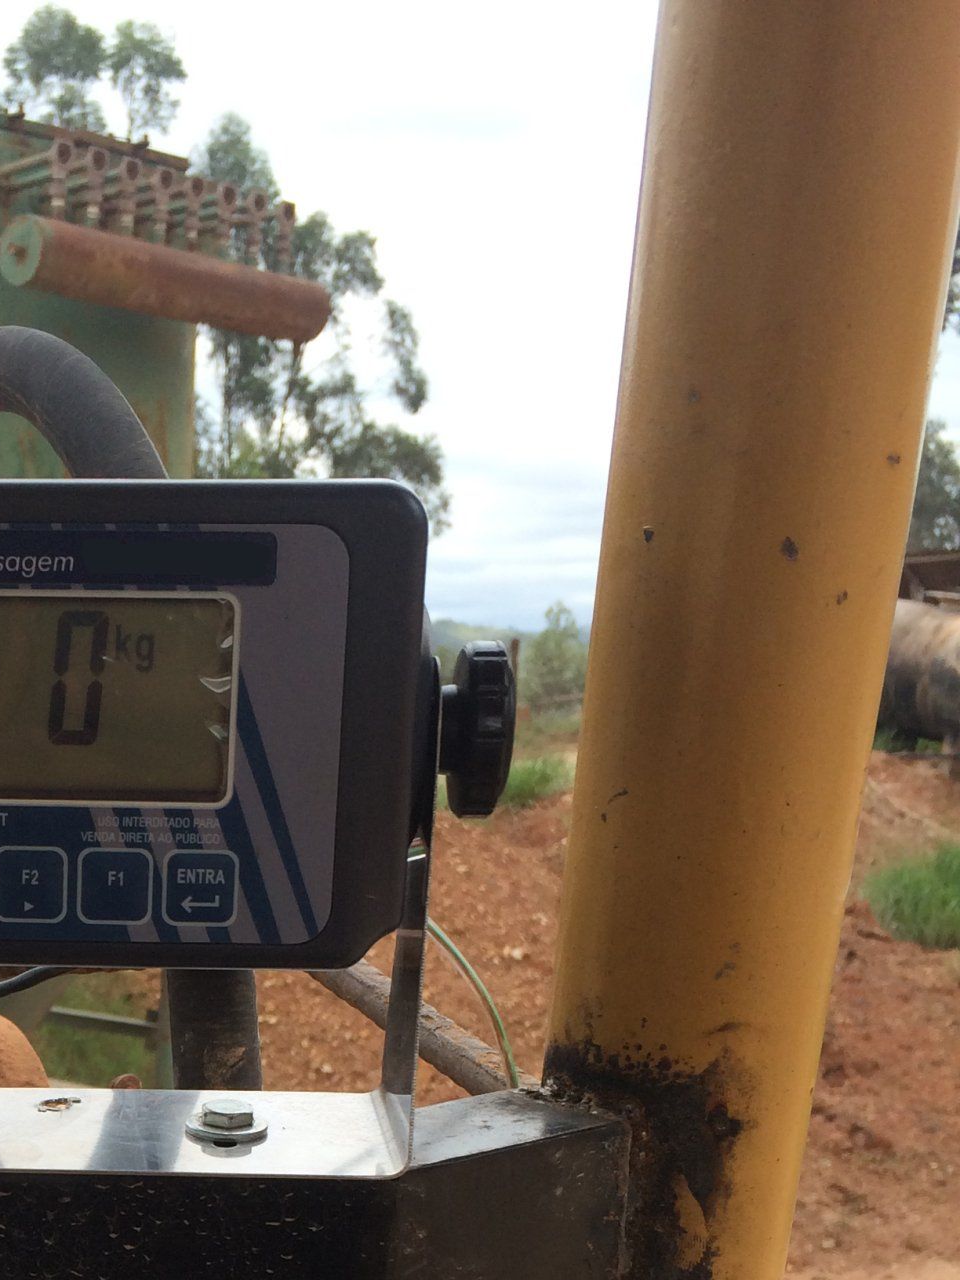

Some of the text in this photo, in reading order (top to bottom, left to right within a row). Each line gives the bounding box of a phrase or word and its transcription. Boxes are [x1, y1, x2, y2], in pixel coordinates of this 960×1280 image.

[48, 611, 155, 745] 0 kg
[98, 816, 220, 829] USO INTERDITADO PARA
[81, 830, 220, 844] VENDA DIRETA AO PÚBLICO
[22, 869, 39, 885] F2
[108, 870, 125, 886] F1
[177, 868, 225, 885] ENTRA
